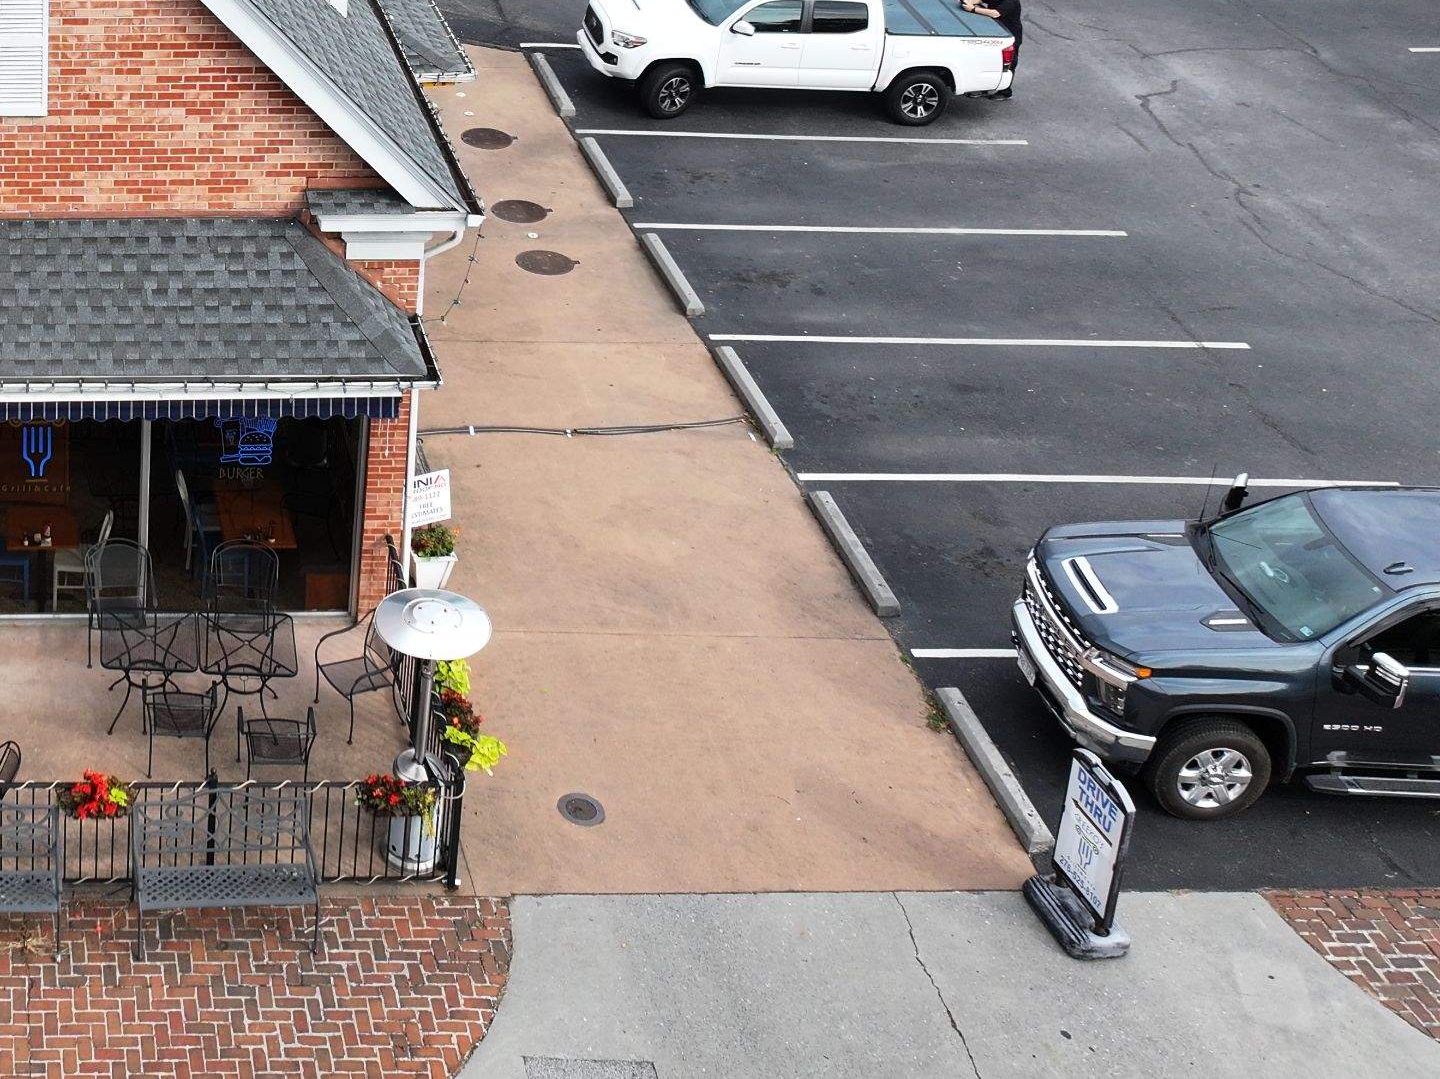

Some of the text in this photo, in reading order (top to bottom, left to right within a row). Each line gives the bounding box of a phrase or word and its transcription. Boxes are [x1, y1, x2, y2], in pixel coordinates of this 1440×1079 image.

[219, 466, 264, 479] BURGER
[1077, 766, 1118, 823] DRIVE
[1078, 785, 1113, 834] THRU
